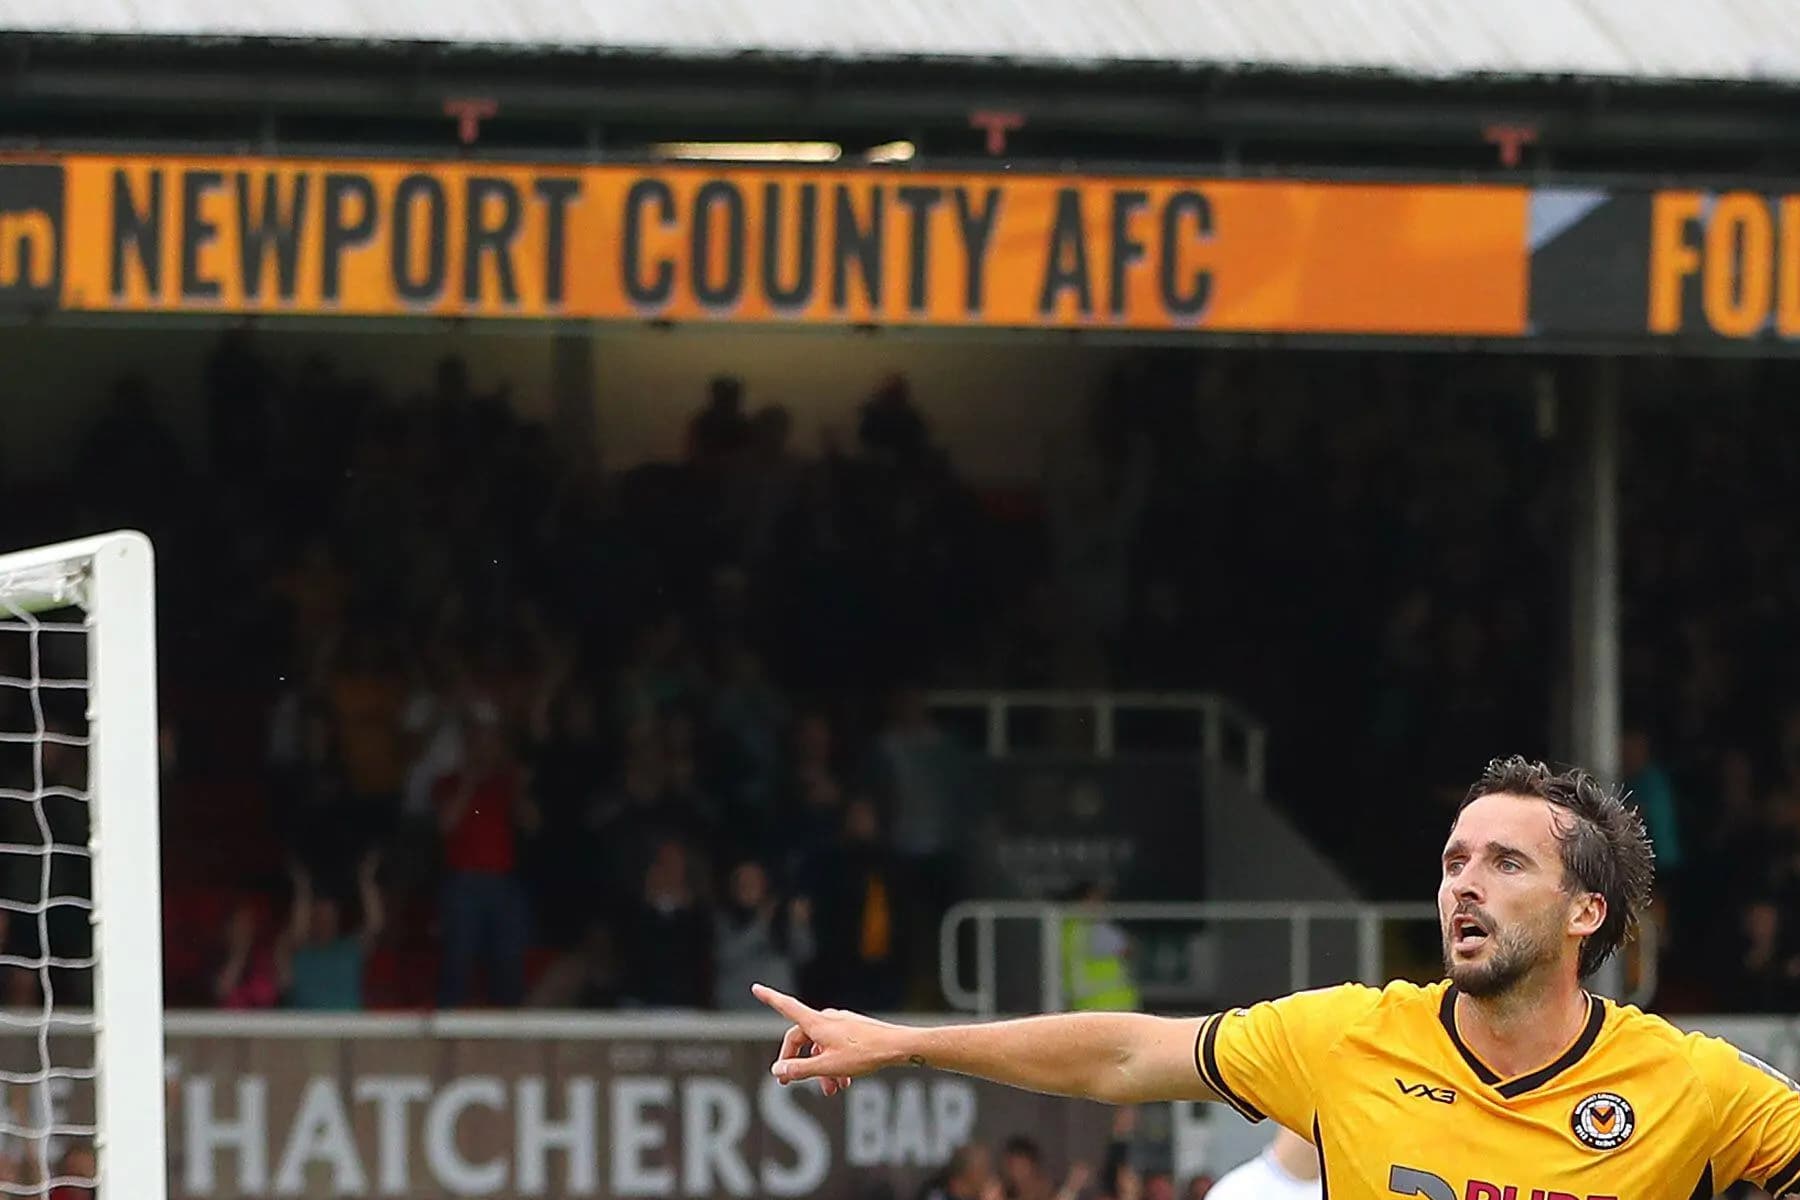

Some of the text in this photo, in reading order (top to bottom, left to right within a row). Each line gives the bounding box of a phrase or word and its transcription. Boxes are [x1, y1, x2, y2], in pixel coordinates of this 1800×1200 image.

[0, 207, 56, 288] n
[111, 168, 1216, 318] NEWPORT COUNTY AFC
[165, 1056, 832, 1197] HATCHERS
